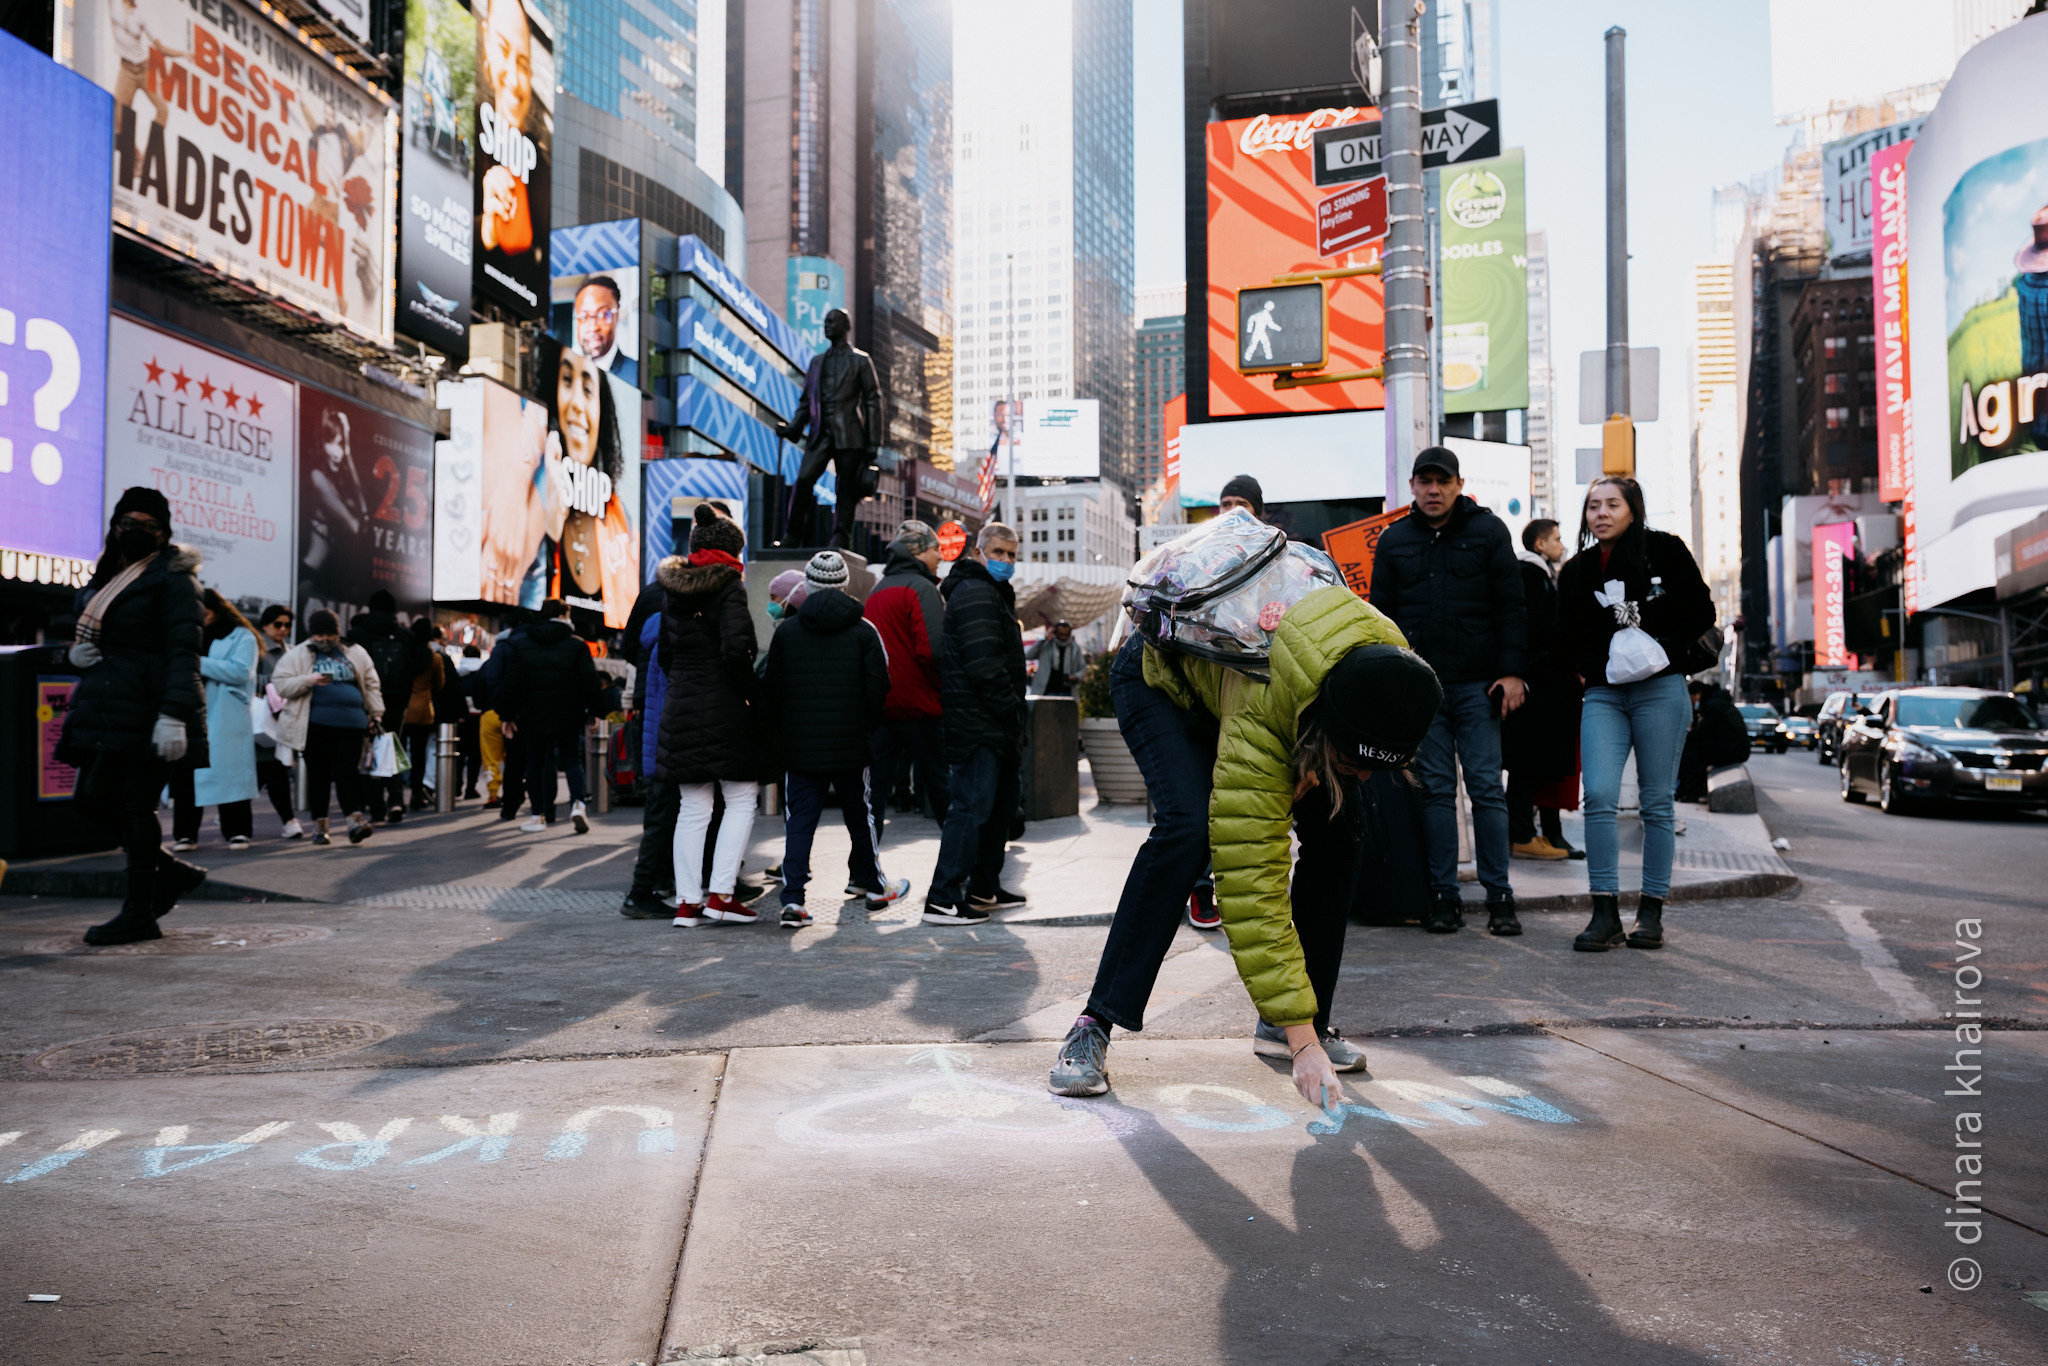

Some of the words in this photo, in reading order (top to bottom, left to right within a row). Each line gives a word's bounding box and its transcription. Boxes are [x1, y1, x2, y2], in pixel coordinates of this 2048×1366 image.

[194, 23, 295, 125] BEST
[147, 46, 328, 197] MUSICAL
[479, 101, 538, 185] SHOP
[1320, 202, 1332, 217] NO
[1333, 187, 1370, 212] STANDING
[1321, 209, 1353, 230] Anytime
[1453, 195, 1503, 212] Green
[205, 409, 273, 462] RISE
[151, 467, 182, 497] TO
[188, 475, 237, 510] KILL
[242, 491, 255, 514] A
[372, 454, 428, 530] 25
[561, 455, 612, 520] SHOP
[168, 498, 276, 542] KINGBIRD
[373, 525, 427, 558] YEARS
[0, 1104, 677, 1183] UKRAI
